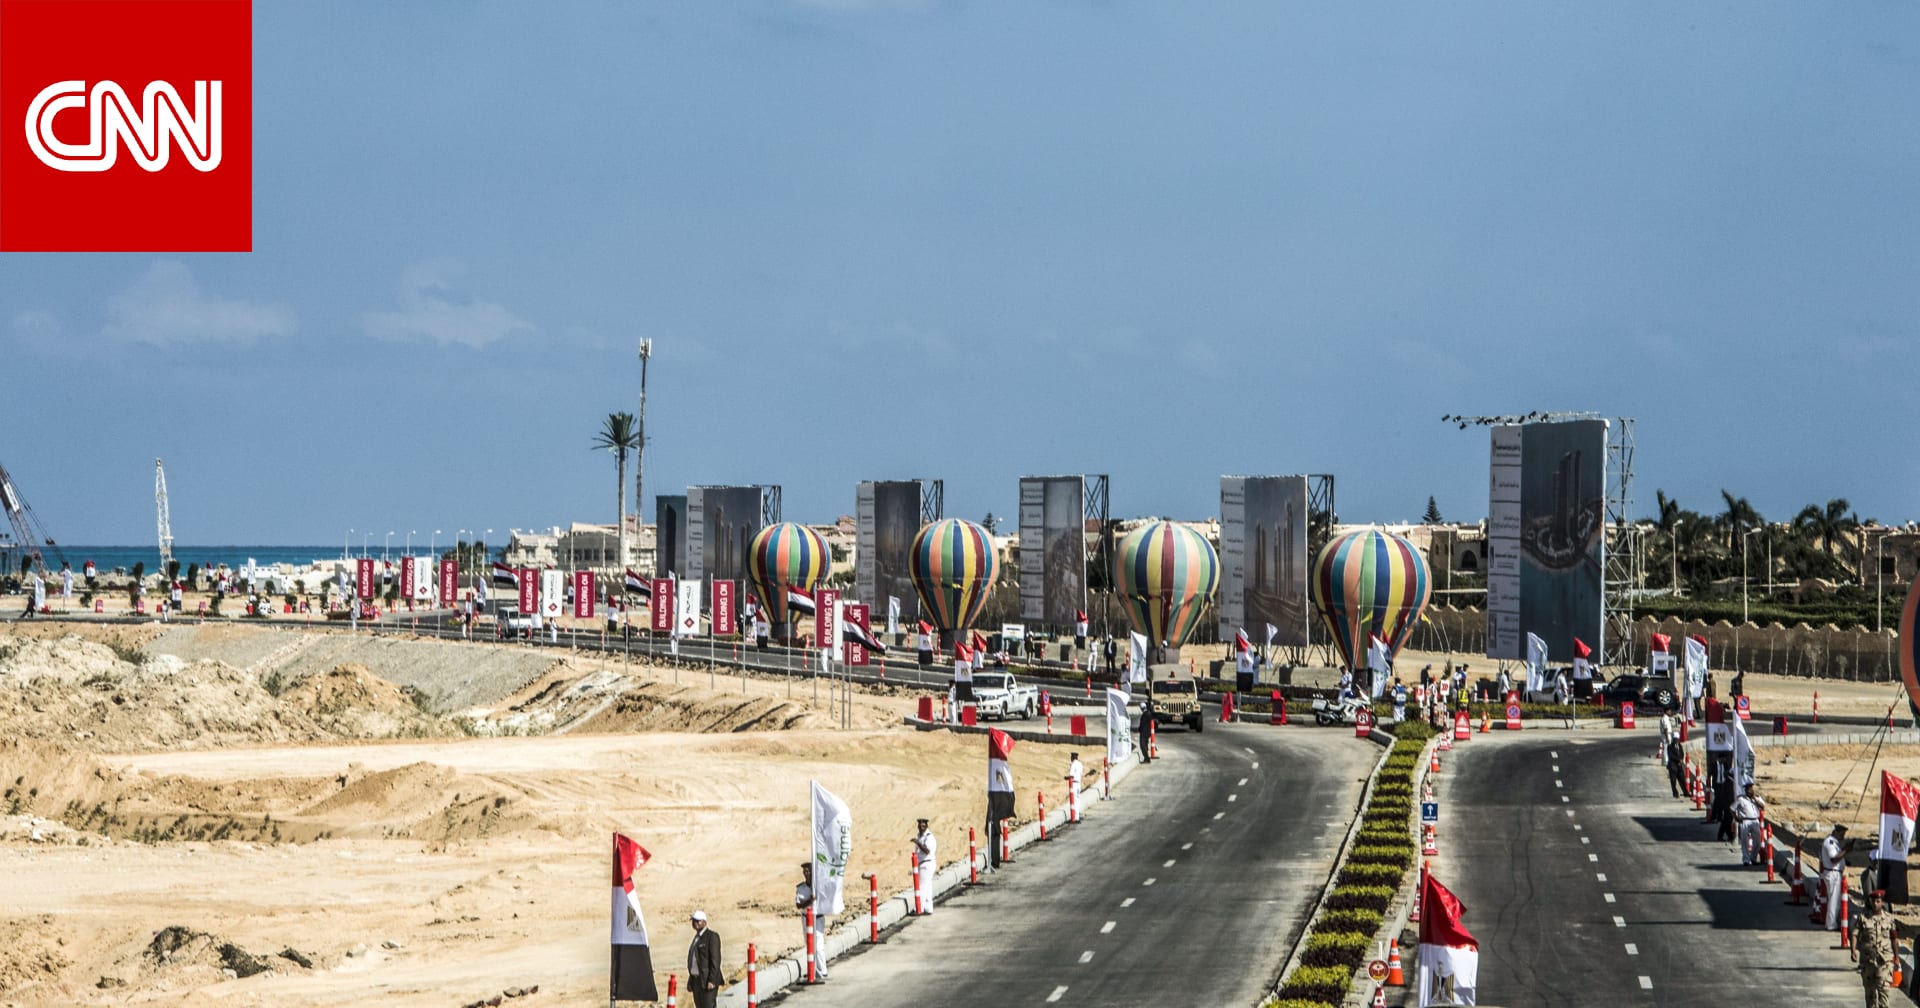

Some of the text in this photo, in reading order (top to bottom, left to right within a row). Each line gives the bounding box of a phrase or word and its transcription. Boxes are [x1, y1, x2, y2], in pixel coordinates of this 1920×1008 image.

[362, 562, 368, 570] ON
[406, 560, 413, 569] ON
[446, 563, 452, 572] ON
[525, 571, 532, 581] ON
[581, 575, 588, 585] ON
[659, 583, 666, 593] ON
[720, 584, 727, 596] ON
[824, 593, 832, 644] BUILDING ON
